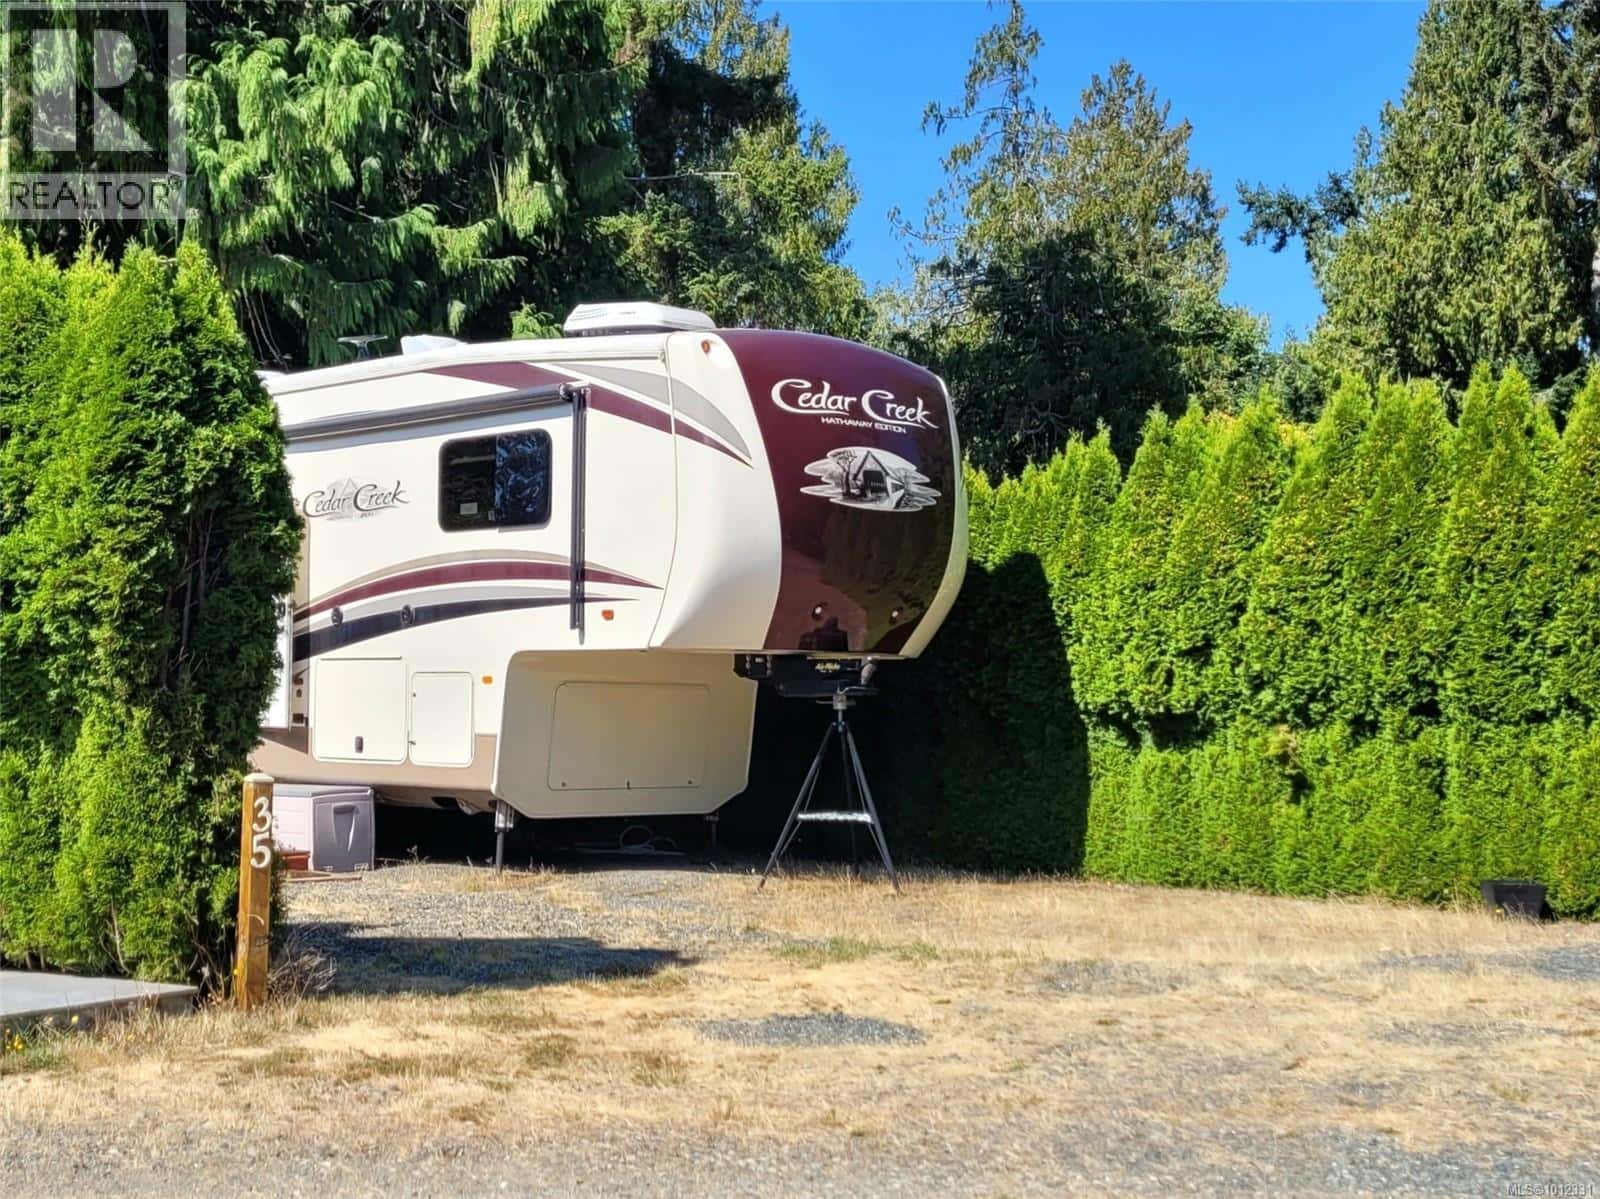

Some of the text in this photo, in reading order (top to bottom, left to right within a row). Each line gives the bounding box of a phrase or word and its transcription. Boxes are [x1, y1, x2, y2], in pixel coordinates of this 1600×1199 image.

[771, 378, 939, 428] Cedar Creek
[821, 416, 907, 434] HATHAWAY EDITION
[303, 479, 410, 517] Cedar Creek
[250, 796, 272, 868] 35
